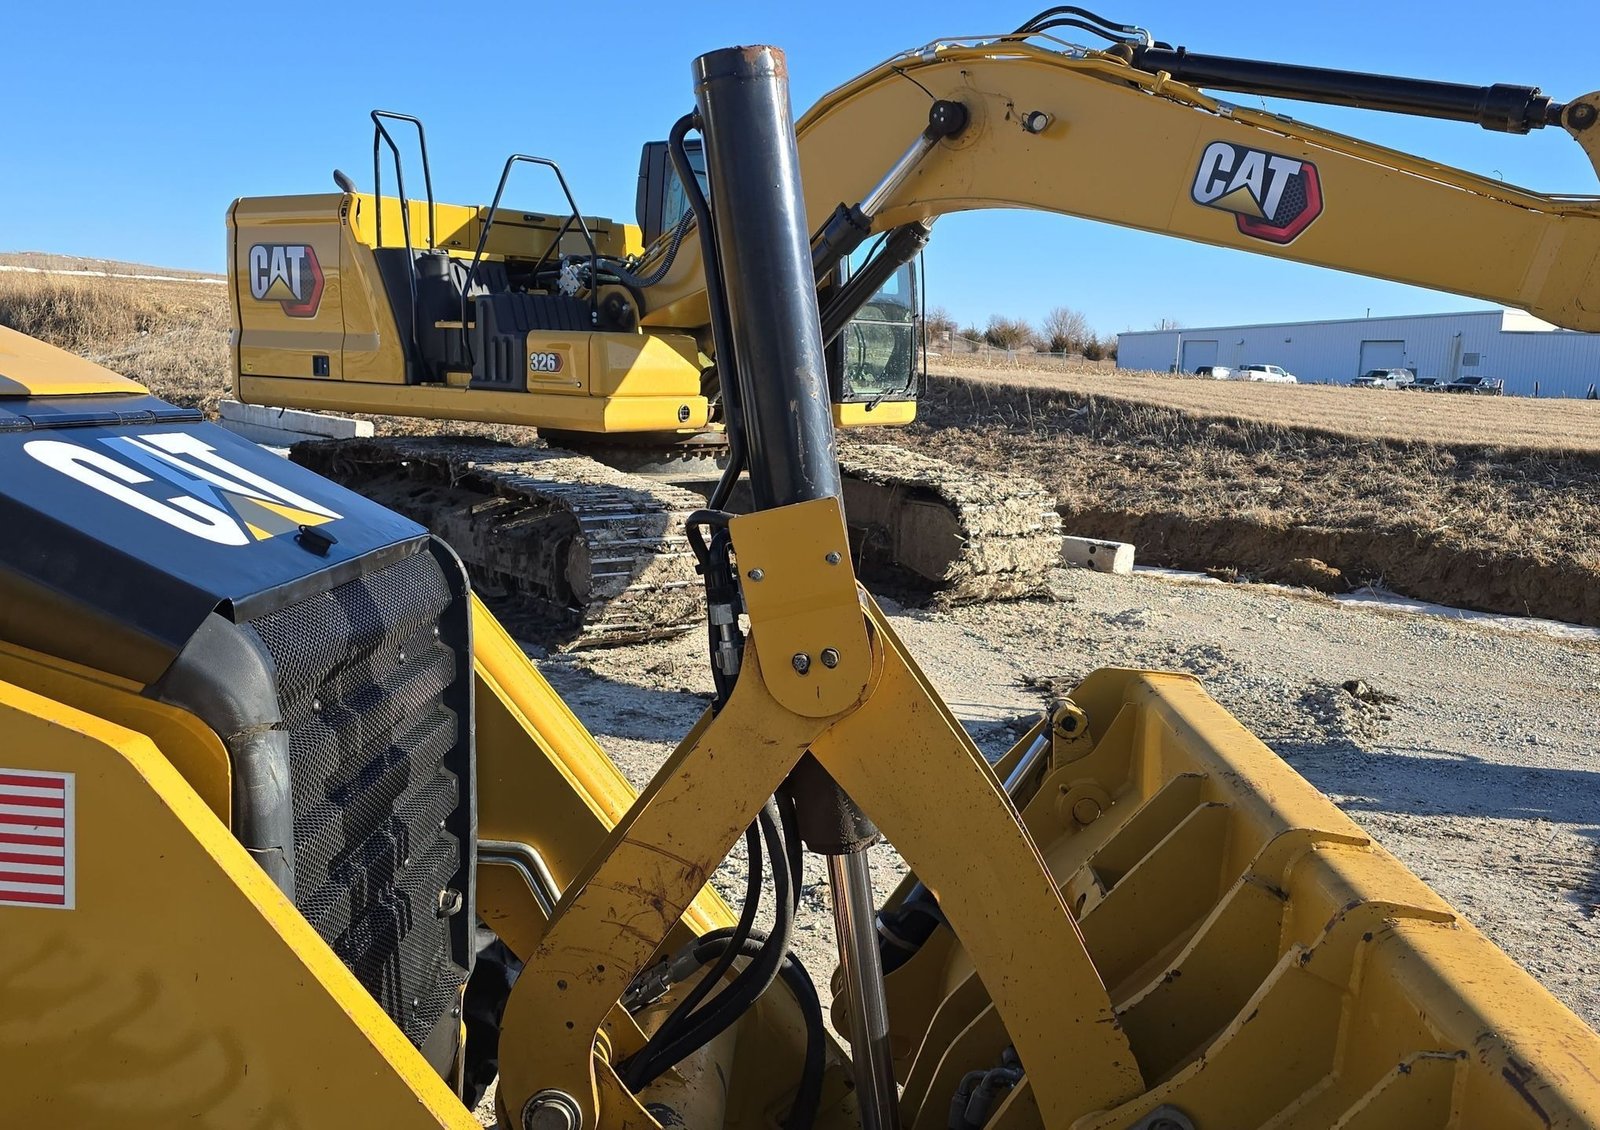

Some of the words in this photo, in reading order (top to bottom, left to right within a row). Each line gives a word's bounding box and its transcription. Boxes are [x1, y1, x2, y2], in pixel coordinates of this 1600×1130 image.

[1193, 142, 1302, 220] CAT
[250, 245, 304, 300] CAT
[530, 353, 556, 371] 326
[23, 432, 344, 546] CAT
